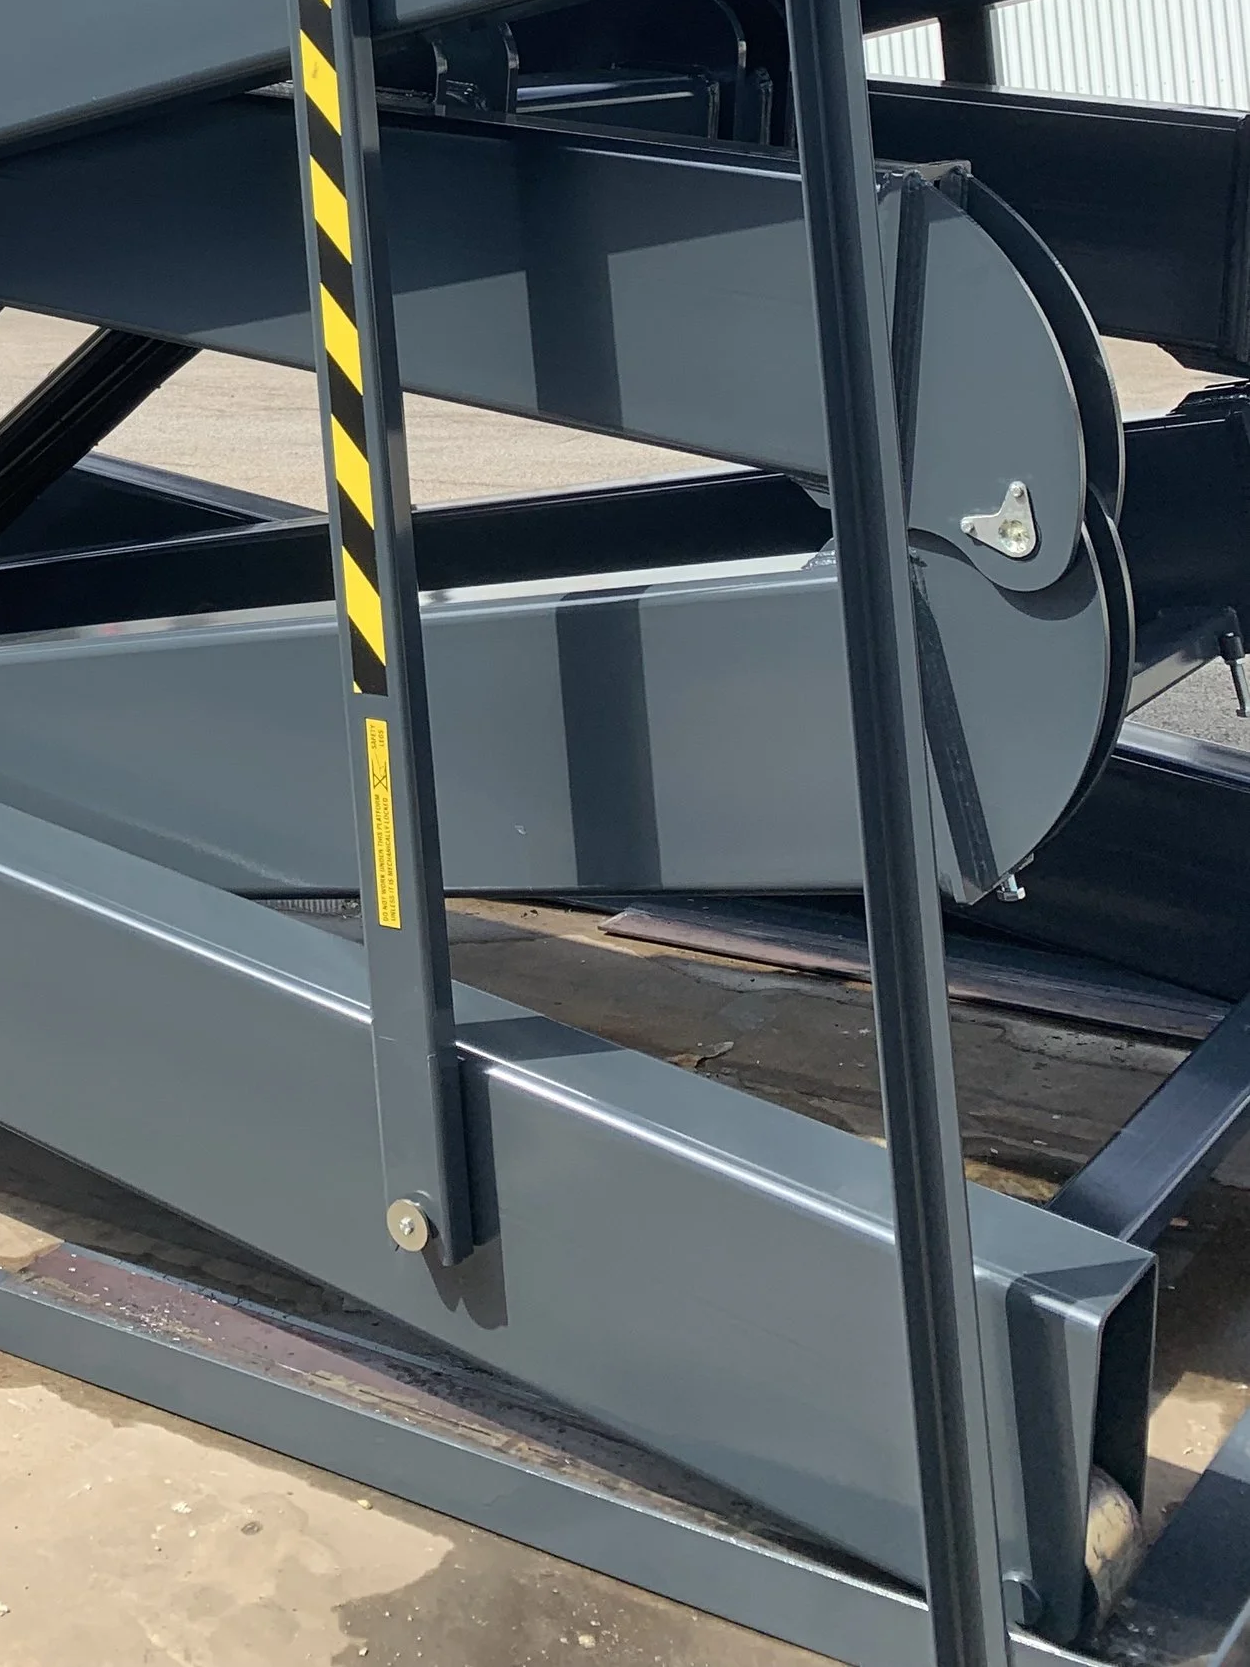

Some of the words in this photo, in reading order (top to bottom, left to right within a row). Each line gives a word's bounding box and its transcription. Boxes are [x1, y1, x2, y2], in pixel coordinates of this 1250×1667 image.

[374, 794, 383, 830] PLATFORM
[382, 797, 390, 824] LOCKED
[384, 825, 393, 876] MECHANICALLY
[382, 912, 389, 922] DO
